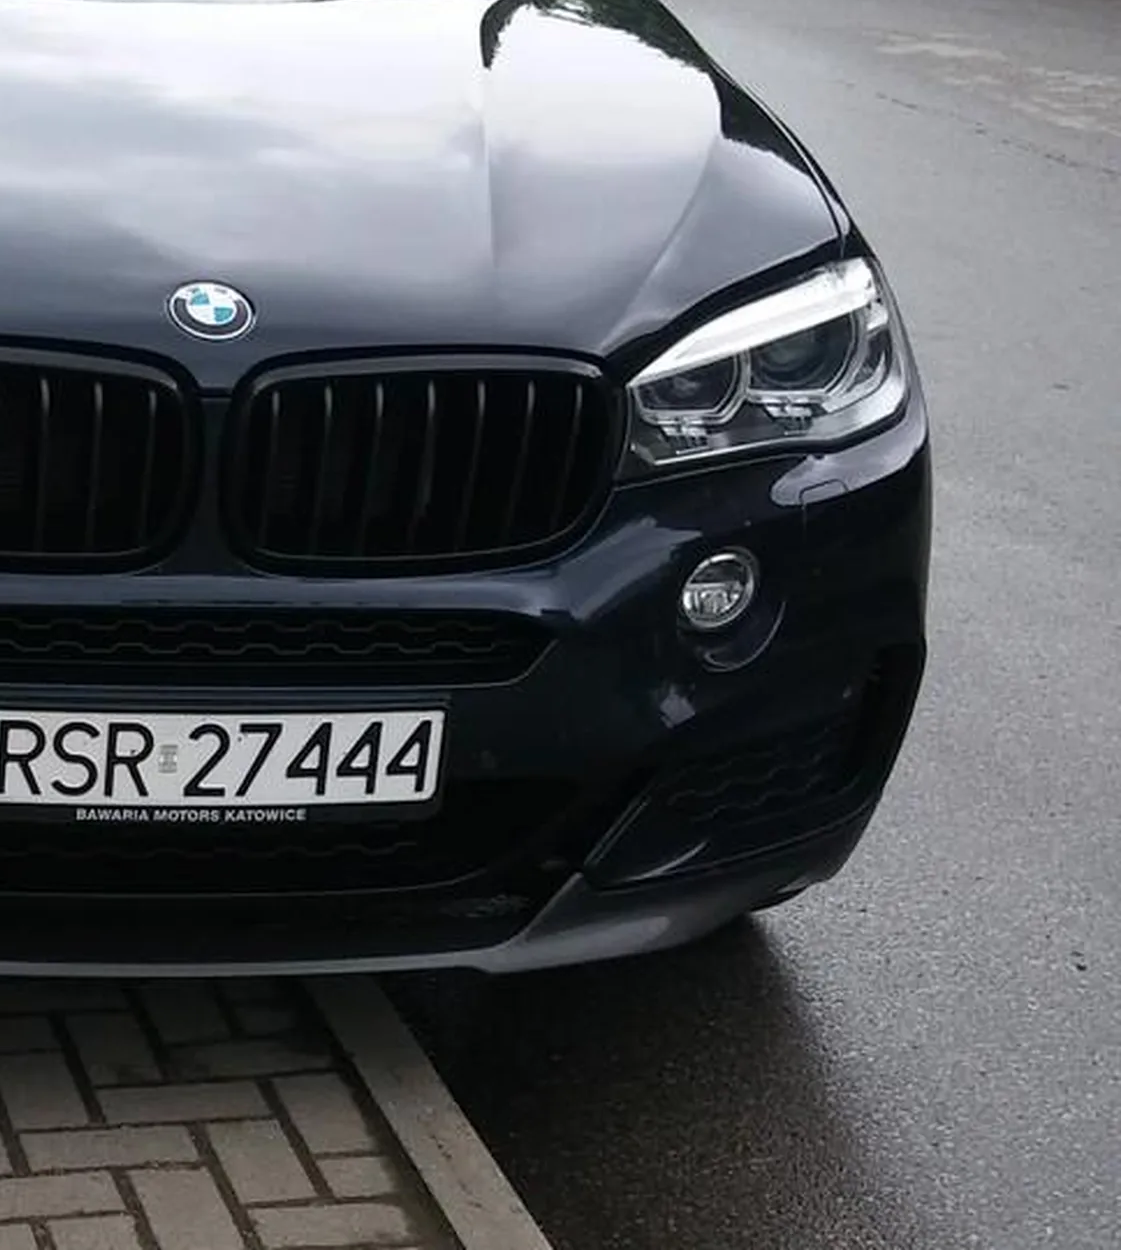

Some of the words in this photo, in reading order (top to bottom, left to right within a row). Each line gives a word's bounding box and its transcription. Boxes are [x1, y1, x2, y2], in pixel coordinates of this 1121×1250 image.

[183, 719, 432, 797] 27444
[76, 808, 149, 822] BAWARIA
[153, 808, 220, 822] MOTORS
[224, 808, 307, 822] KATOWICE
